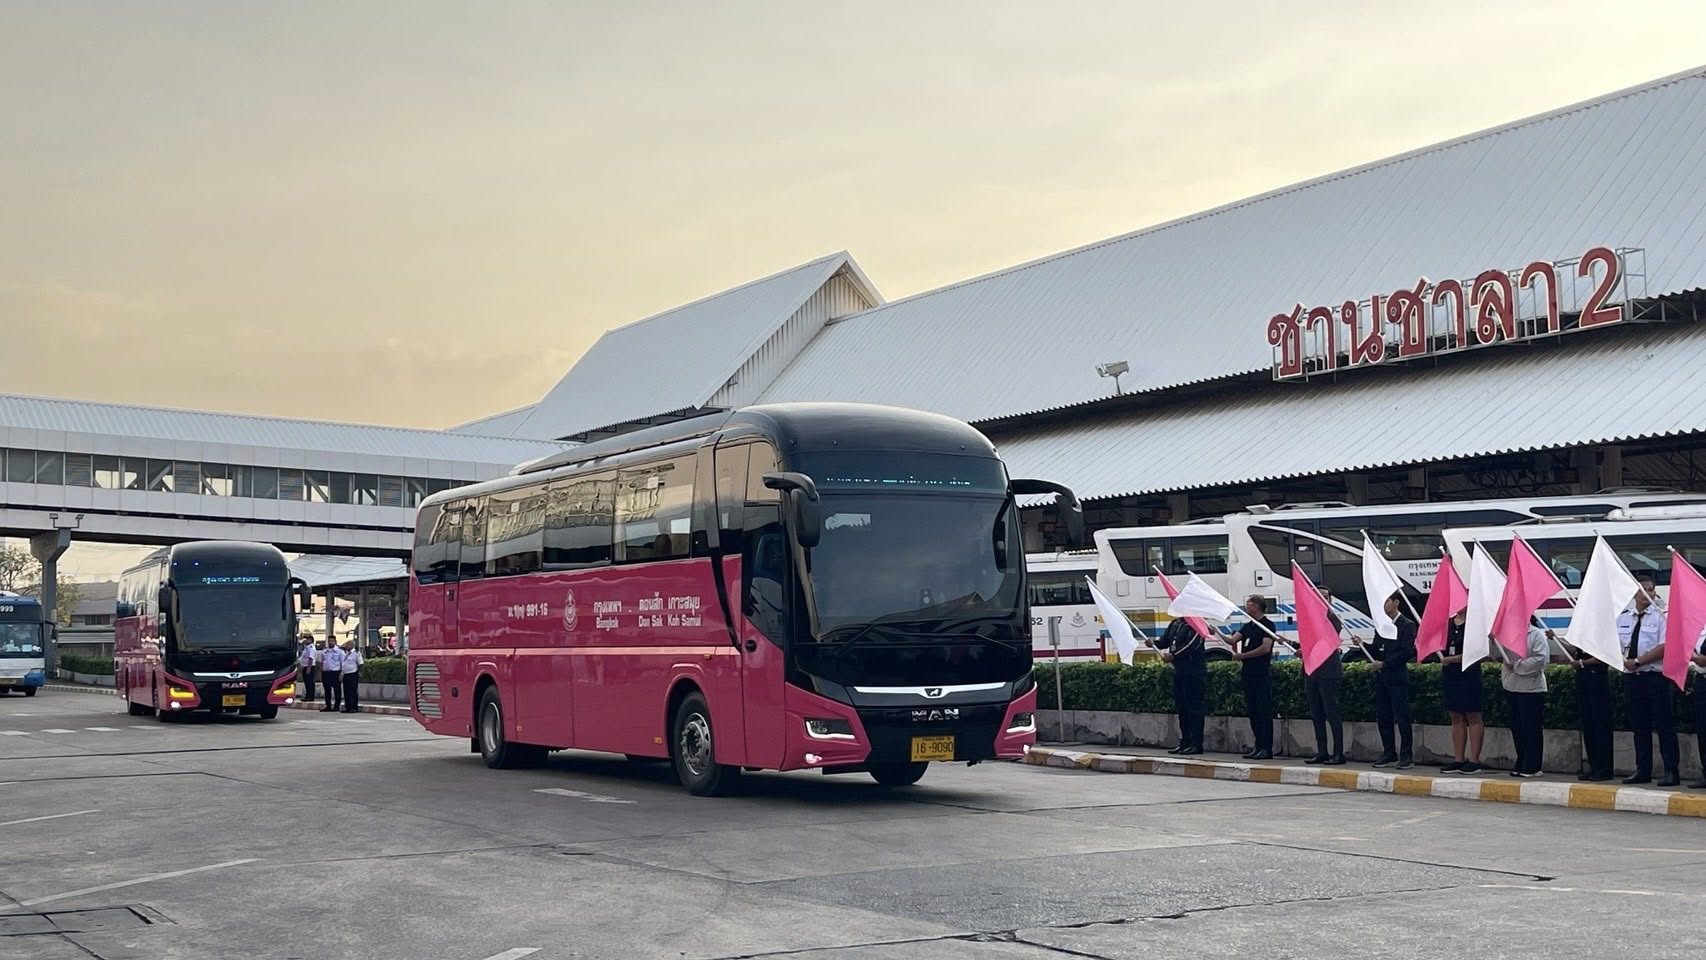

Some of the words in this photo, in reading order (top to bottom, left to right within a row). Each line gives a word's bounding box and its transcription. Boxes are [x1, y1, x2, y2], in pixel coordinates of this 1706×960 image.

[1266, 261, 1560, 378] ชานชาลา
[1578, 246, 1624, 328] 2
[594, 600, 622, 618] กรุงเทพฯ
[639, 591, 664, 611] ดอนสัก
[667, 596, 700, 616] เกาะสมุย
[596, 616, 619, 631] Bangkok
[638, 615, 650, 627] Don
[651, 614, 663, 627] Sak
[667, 614, 680, 627] Koh
[681, 613, 702, 627] Samui
[911, 708, 959, 721] MAN
